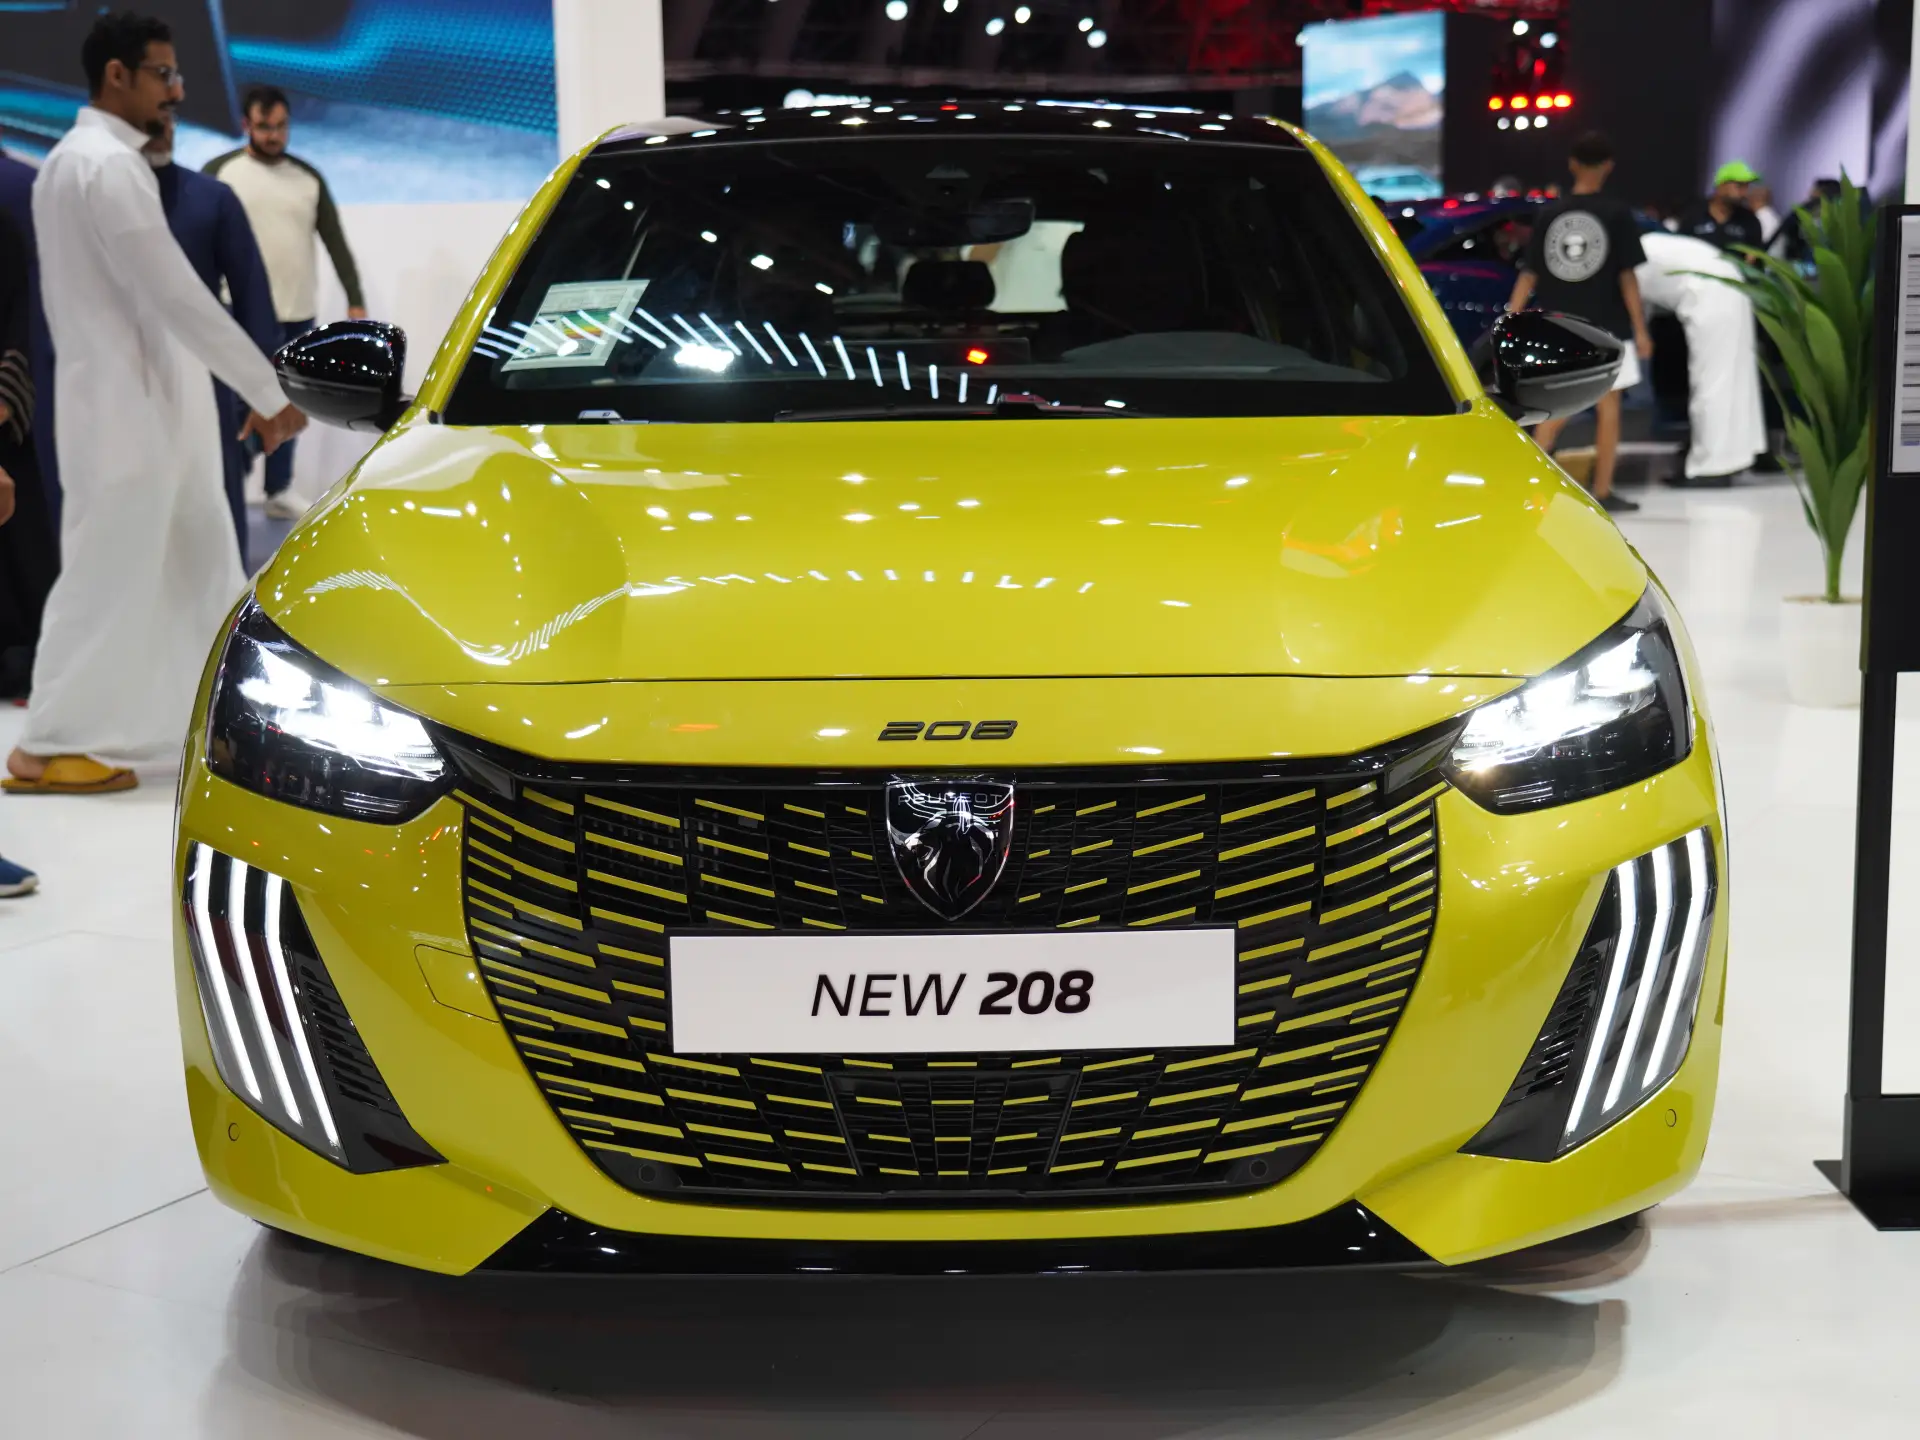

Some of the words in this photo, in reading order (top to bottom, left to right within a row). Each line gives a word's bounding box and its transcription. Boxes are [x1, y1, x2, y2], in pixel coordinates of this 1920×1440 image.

[878, 720, 1018, 741] 208
[898, 791, 1003, 806] PEUGEOT
[811, 973, 966, 1016] NEW
[979, 970, 1094, 1015] 208
